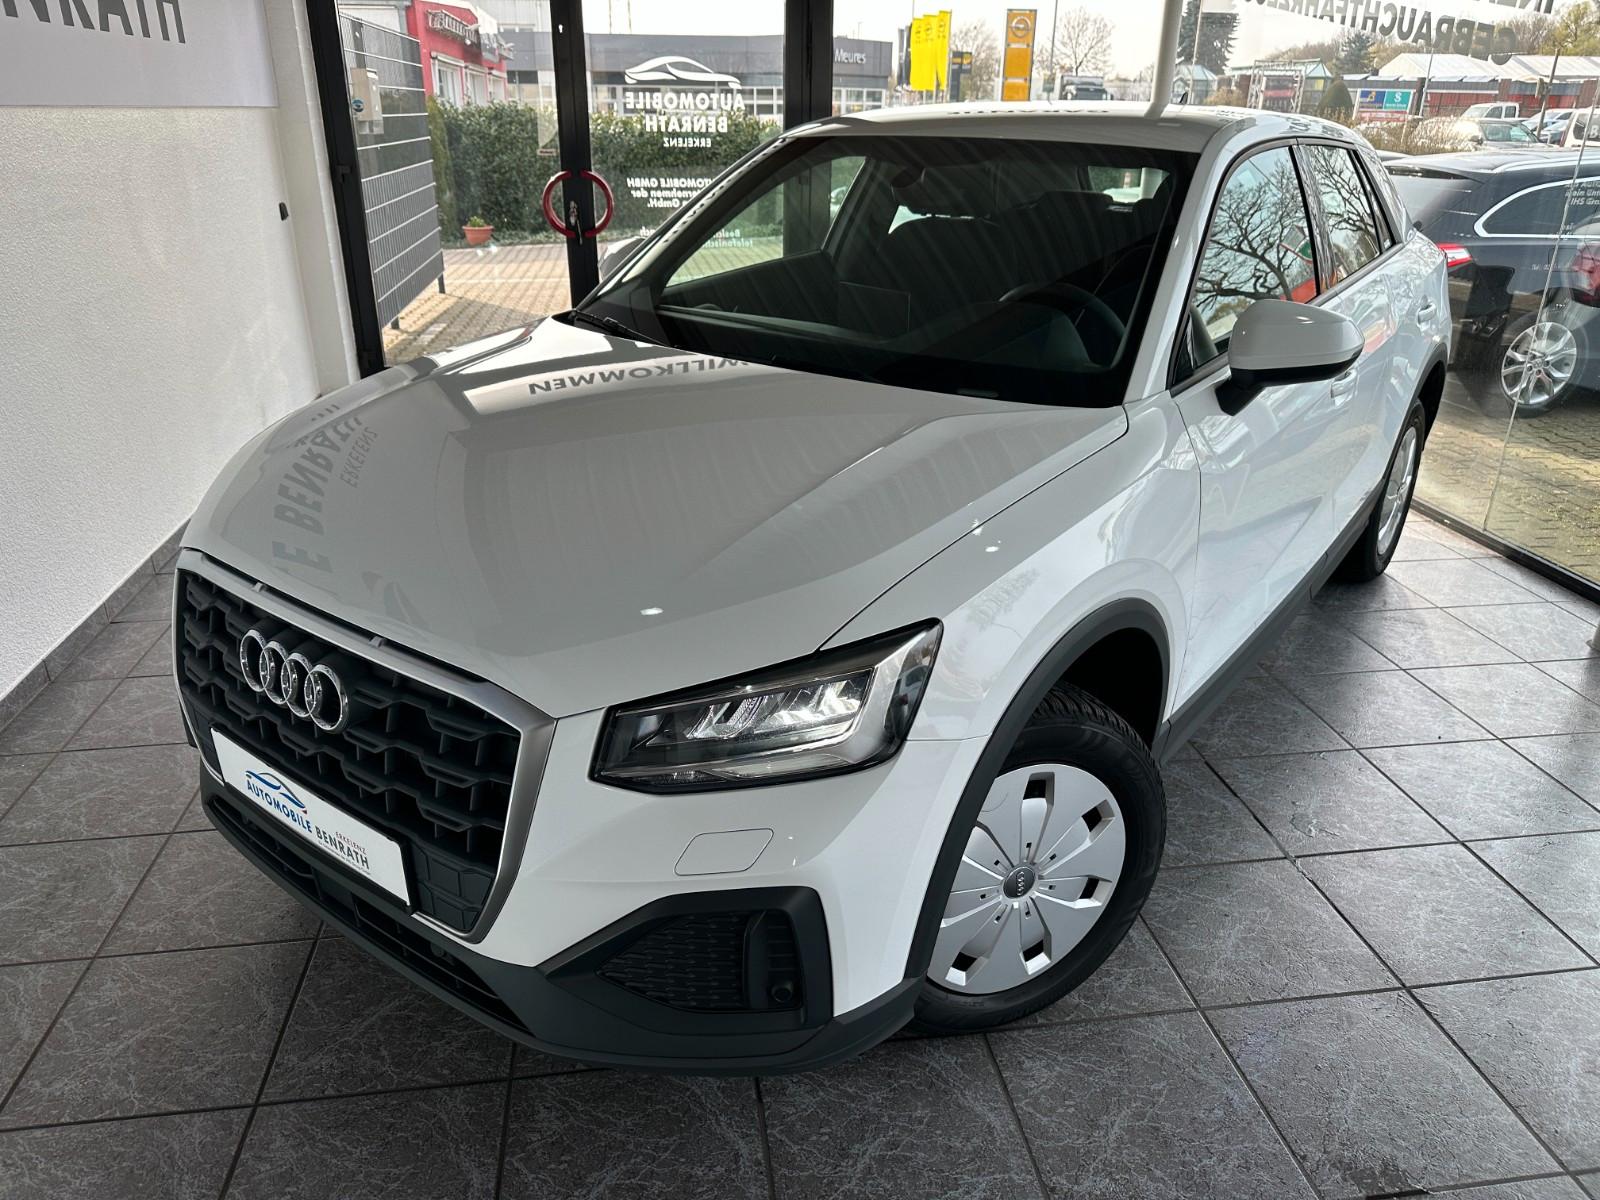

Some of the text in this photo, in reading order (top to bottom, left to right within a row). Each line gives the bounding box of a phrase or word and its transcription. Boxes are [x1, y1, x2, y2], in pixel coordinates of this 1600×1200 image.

[834, 48, 866, 64] Meures
[528, 357, 748, 395] WILLKOMMEN
[246, 779, 313, 833] AUTOMOBILE
[314, 825, 370, 870] BENRATH
[335, 831, 368, 856] ERKELENZ
